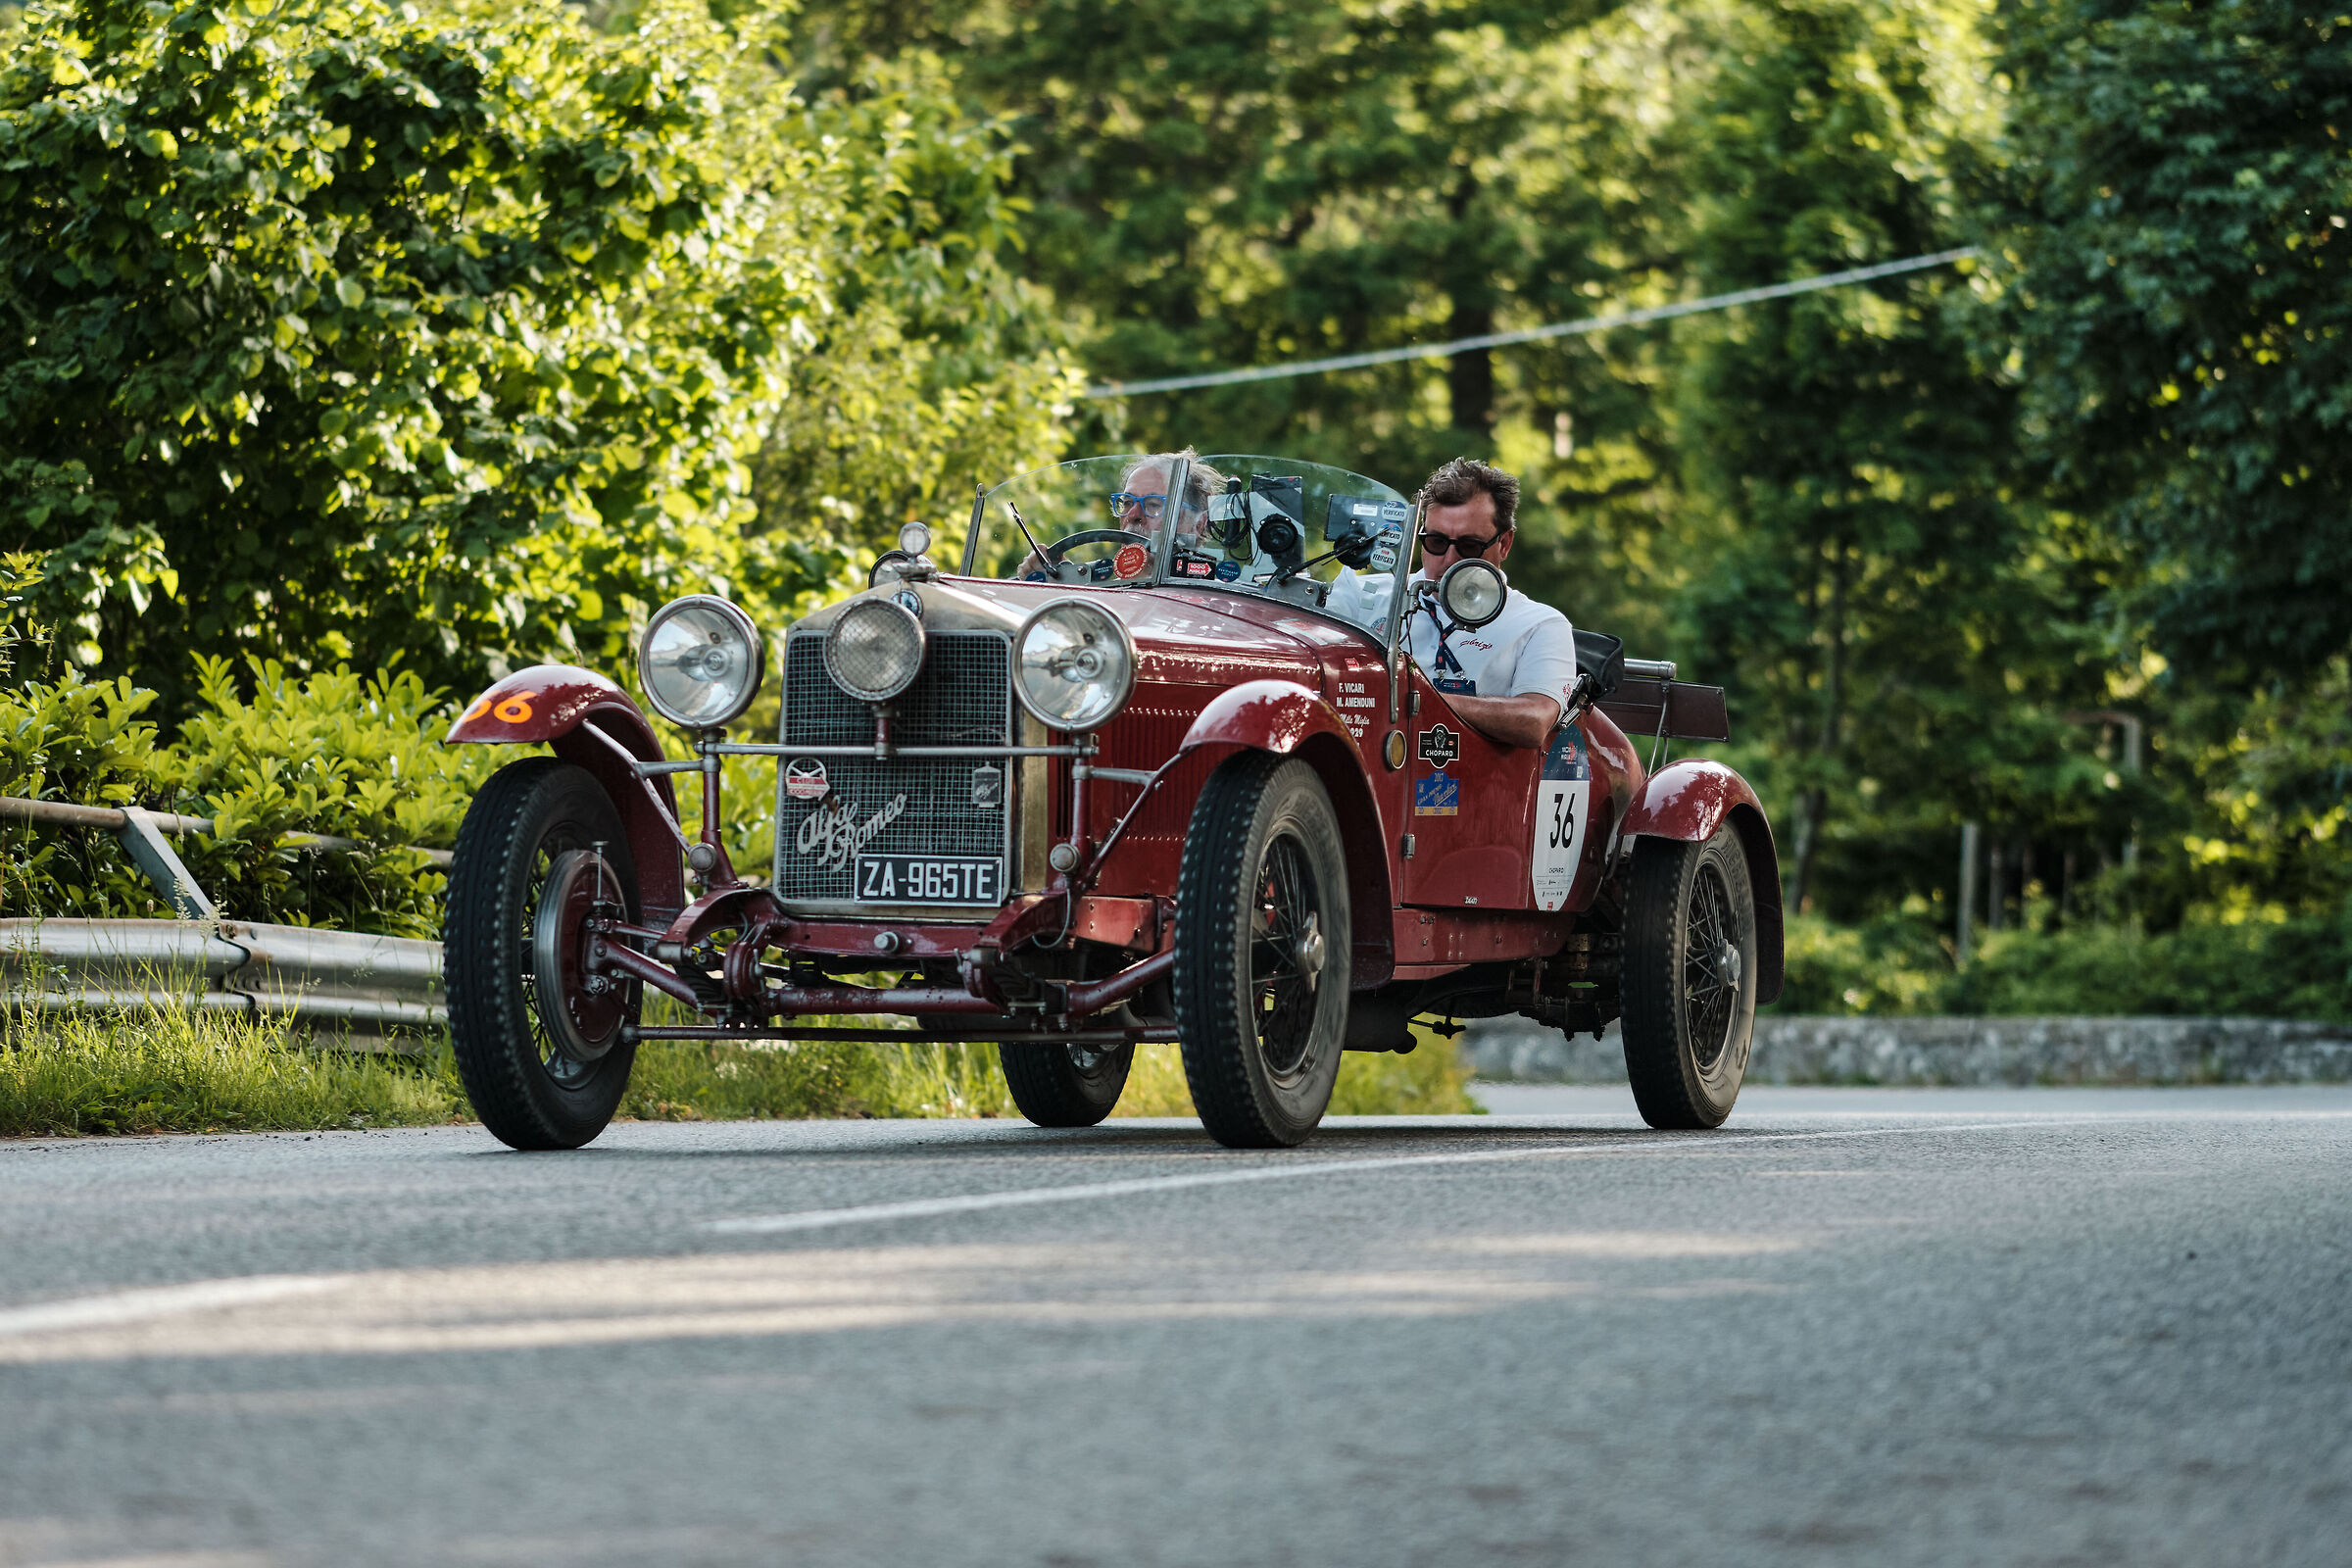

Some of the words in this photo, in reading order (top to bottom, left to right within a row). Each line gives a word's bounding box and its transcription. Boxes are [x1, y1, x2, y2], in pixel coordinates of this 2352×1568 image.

[1372, 553, 1395, 564] VERIFICATO
[1339, 682, 1345, 693] F.
[1344, 682, 1364, 694] VICARI
[1336, 697, 1344, 707] M.
[1345, 697, 1376, 708] AMENDUNI
[1349, 727, 1363, 737] 929
[1425, 749, 1453, 758] CHOPARD
[1549, 793, 1576, 849] 36
[823, 793, 907, 872] Romeo
[862, 861, 994, 900] ZA-965TE
